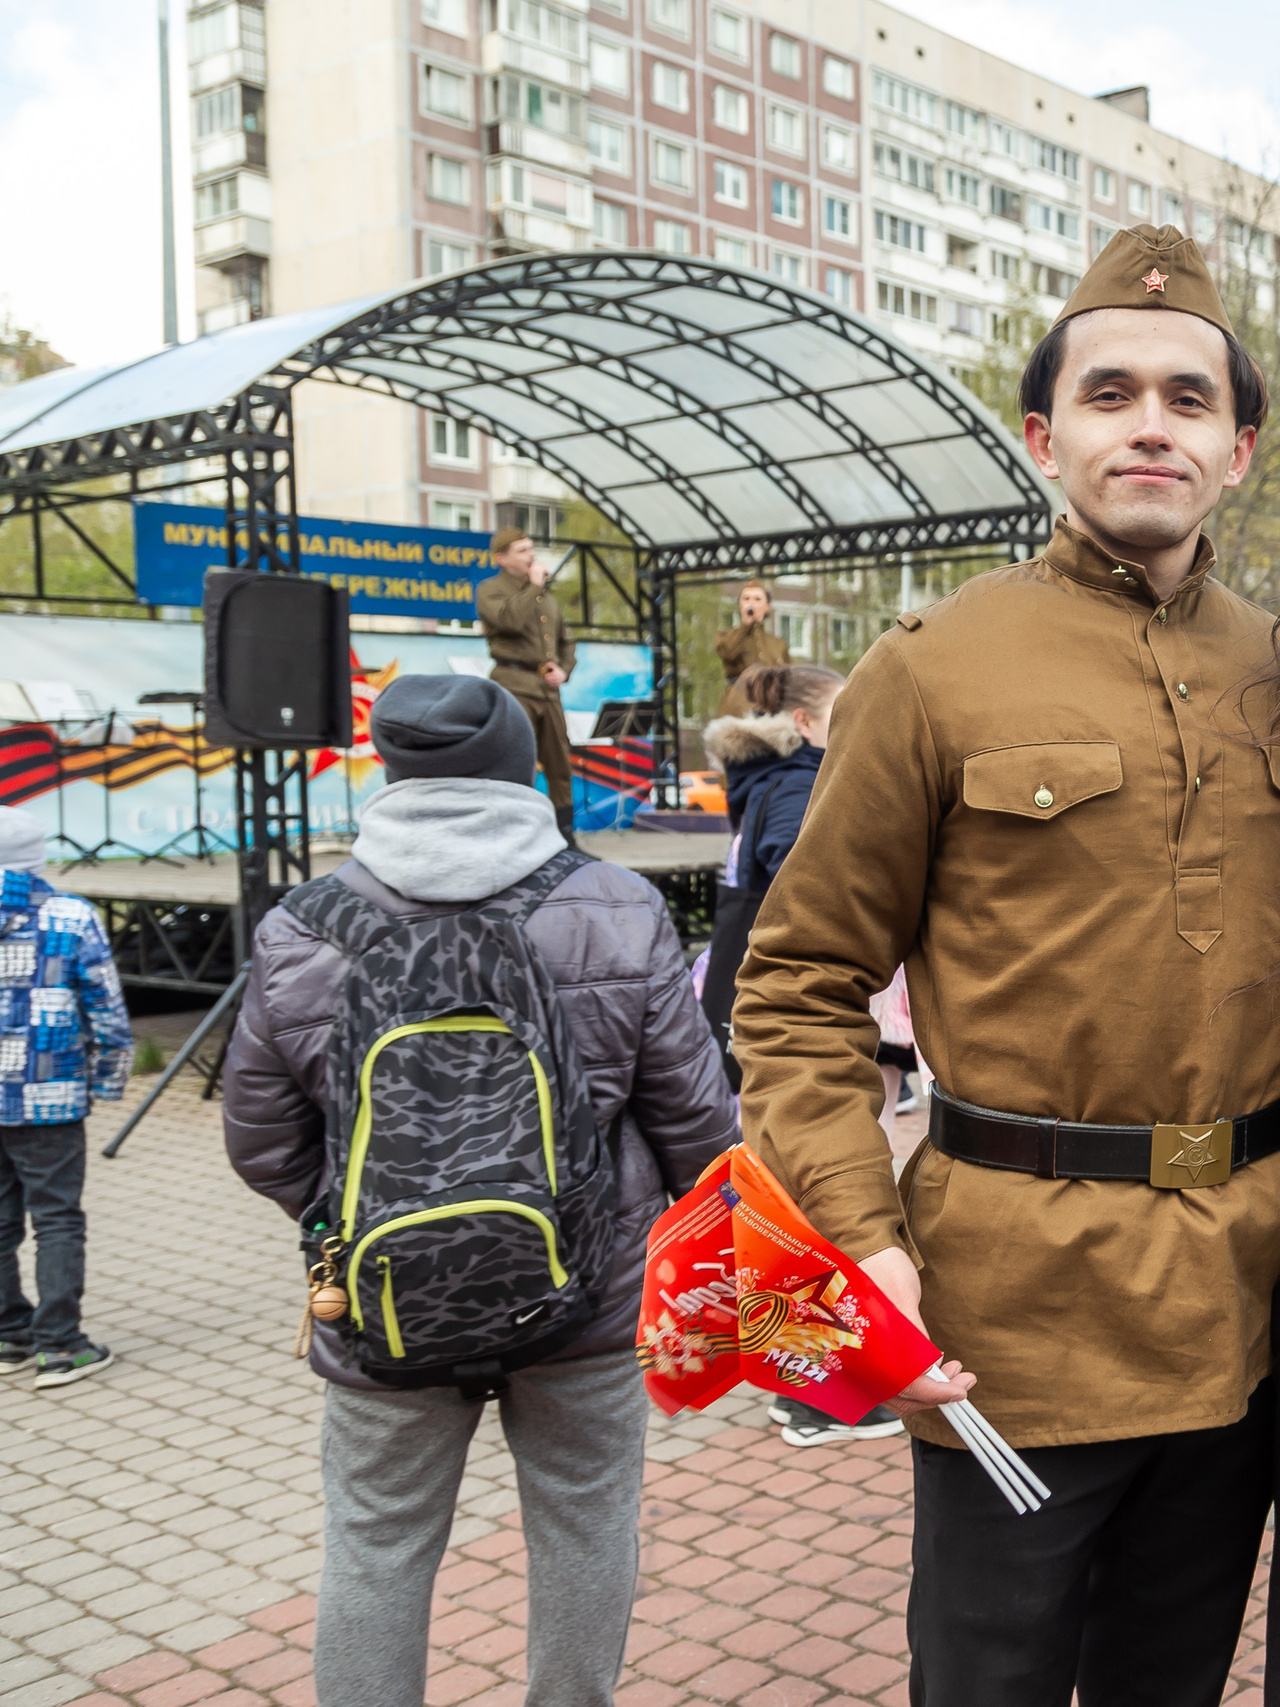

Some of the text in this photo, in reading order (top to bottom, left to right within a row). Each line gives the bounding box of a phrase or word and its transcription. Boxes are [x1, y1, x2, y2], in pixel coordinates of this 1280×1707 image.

[734, 1206, 806, 1258] ПРАВОБЕРЕЖНЫЙ
[738, 1201, 812, 1253] МУНИЦИПАЛЬНЫЙ
[811, 1250, 839, 1269] ОКРУГ
